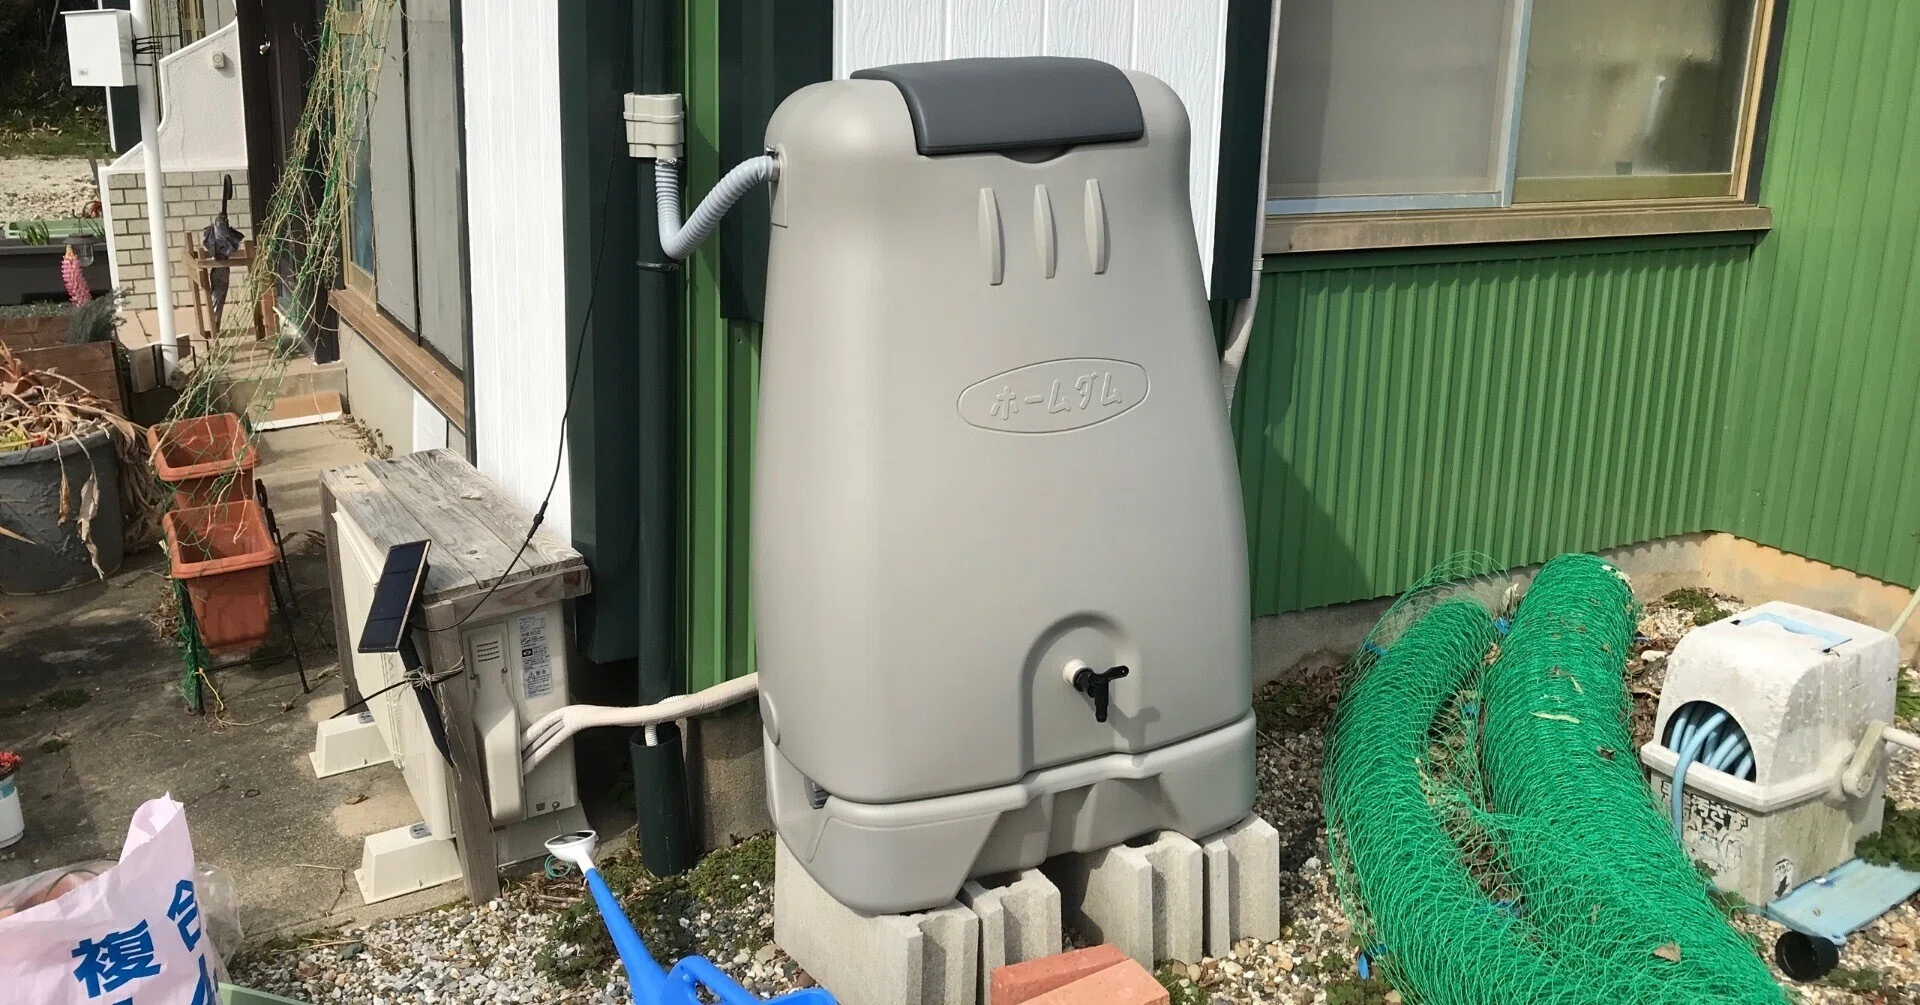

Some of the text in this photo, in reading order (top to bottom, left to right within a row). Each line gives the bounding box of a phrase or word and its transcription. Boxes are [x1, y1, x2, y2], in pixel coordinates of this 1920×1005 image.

[990, 371, 1123, 420] ホームダム
